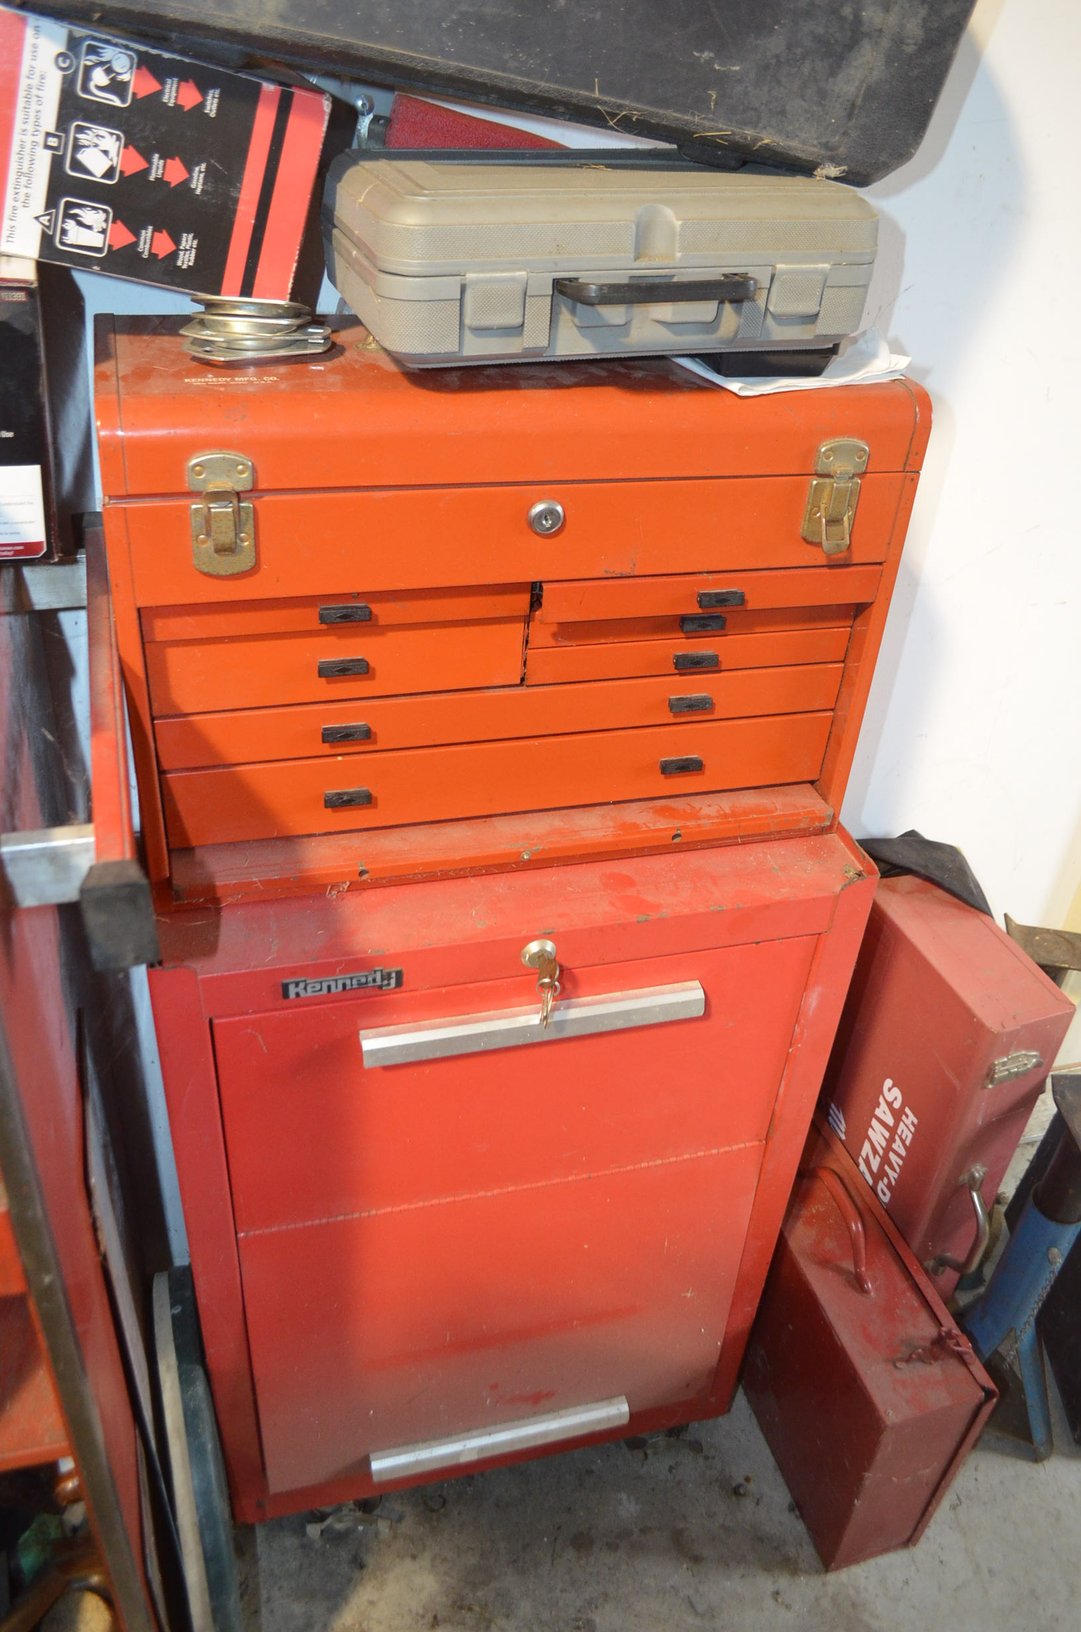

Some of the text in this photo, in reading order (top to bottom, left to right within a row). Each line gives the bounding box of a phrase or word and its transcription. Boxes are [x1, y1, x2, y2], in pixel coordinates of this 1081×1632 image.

[34, 94, 43, 106] of
[161, 78, 171, 103] Electrical
[168, 77, 179, 107] Equipment
[5, 25, 41, 243] This fire extinguisher is suitable for use on
[31, 109, 42, 137] types
[22, 140, 39, 189] following
[148, 153, 160, 181] Flammable
[155, 160, 165, 178] Liquids
[21, 192, 32, 208] the
[137, 230, 146, 251] Common
[141, 225, 153, 258] Combustibles
[288, 968, 397, 999] Kennedy
[877, 1106, 918, 1208] HEAVY-D
